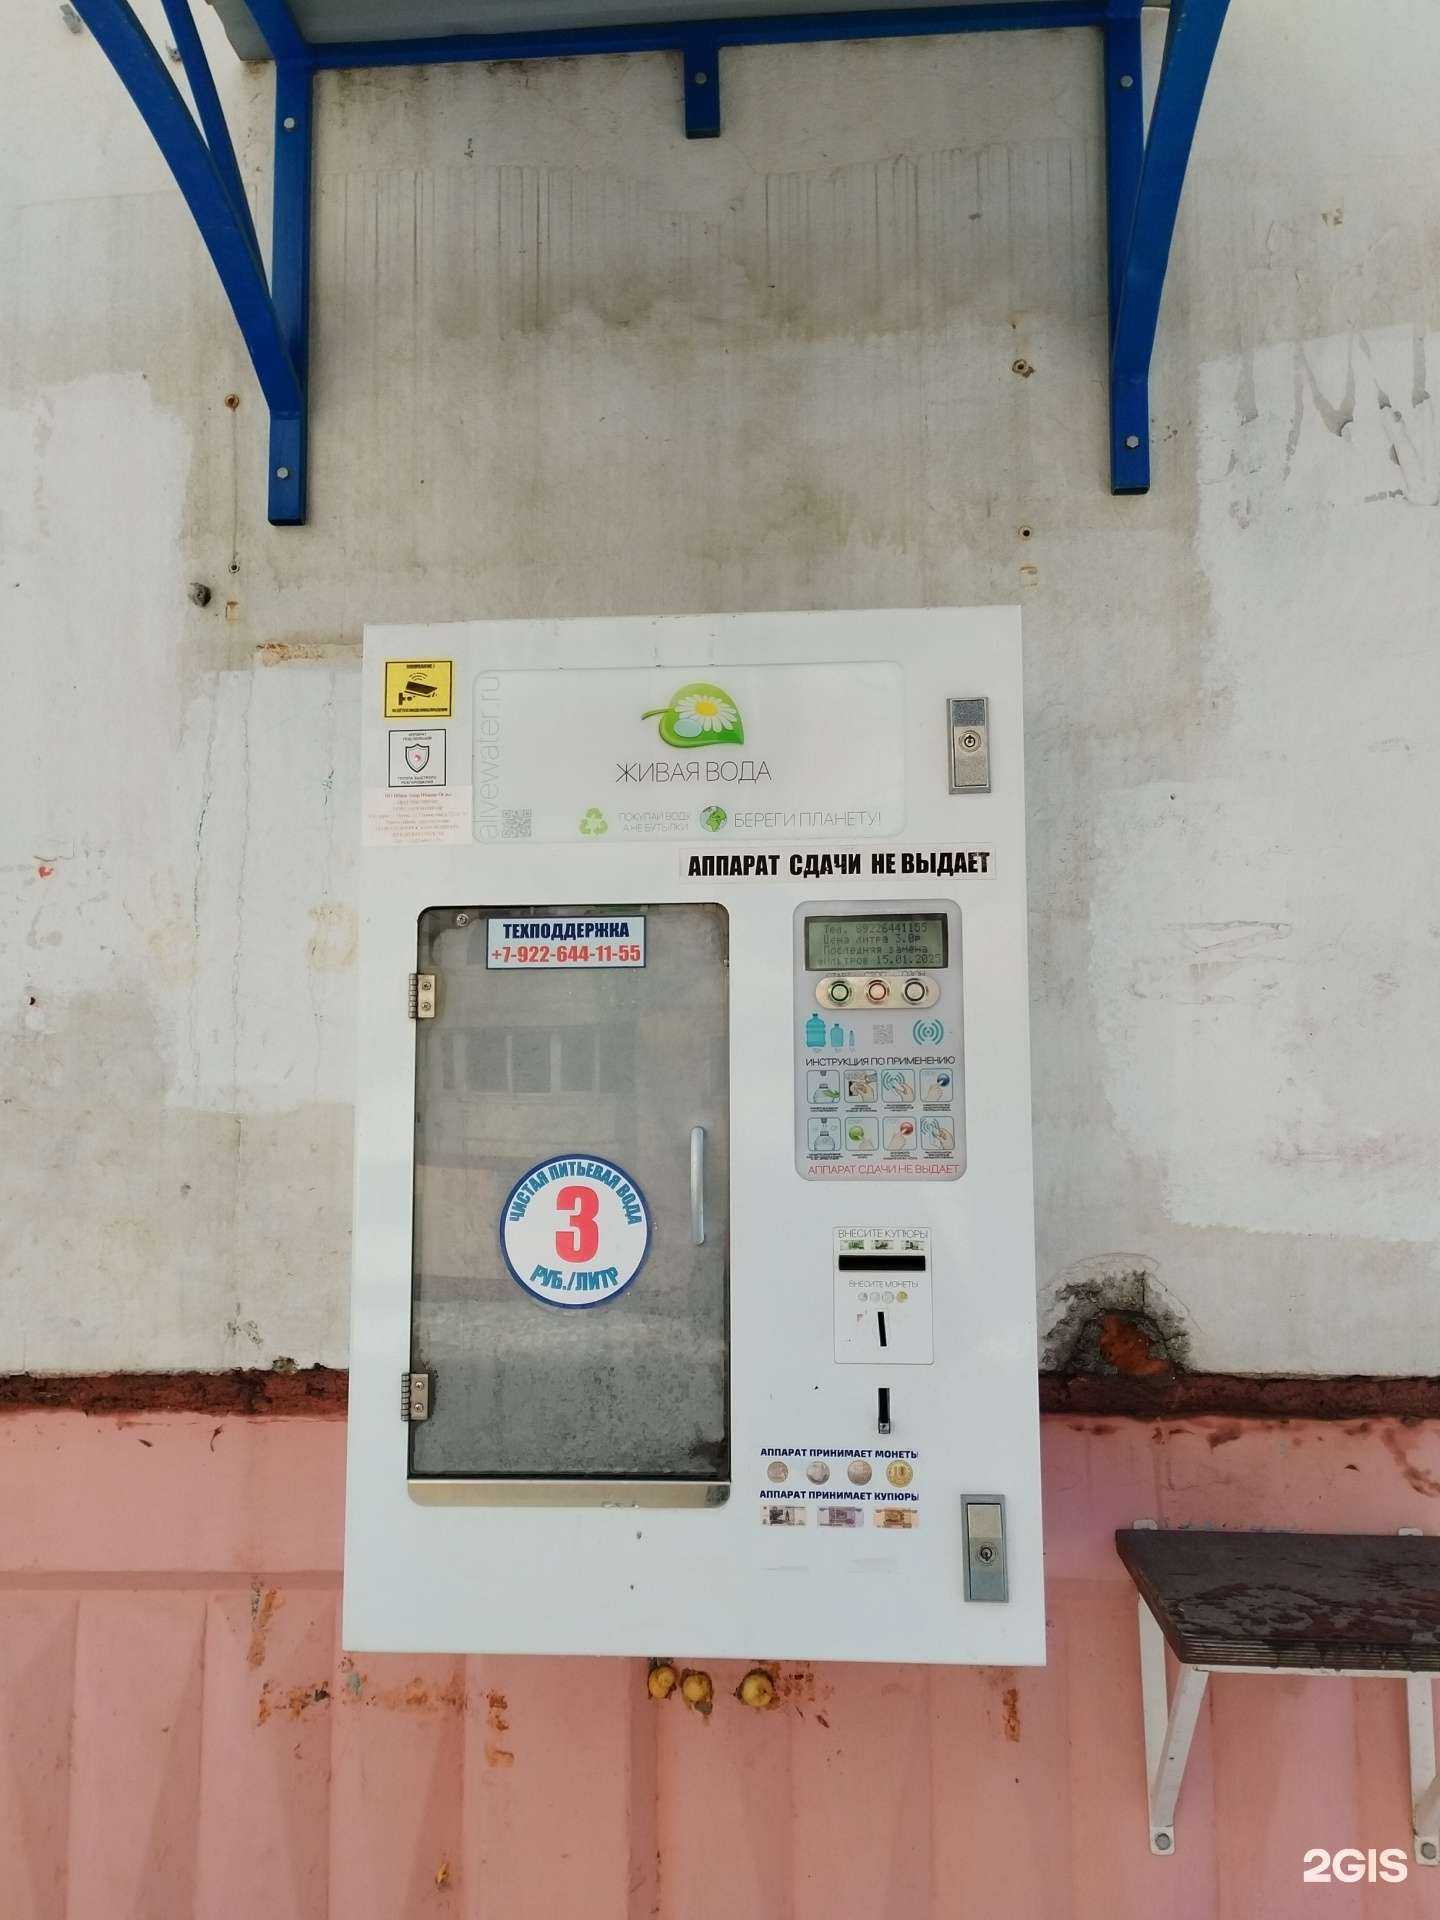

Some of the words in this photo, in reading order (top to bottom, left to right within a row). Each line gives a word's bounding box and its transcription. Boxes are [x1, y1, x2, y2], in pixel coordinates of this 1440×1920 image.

[477, 676, 500, 841] alivewater.ru
[615, 761, 700, 783] ЖИВАЯ
[705, 760, 773, 784] ВОДА
[734, 812, 796, 828] БЕРЕГИ
[799, 811, 881, 827] ПЛАНЕТУ!
[688, 854, 780, 877] АППАРАТ
[789, 853, 862, 878] СДАЧИ
[871, 853, 897, 875] НЕ
[901, 851, 991, 877] ВЫДАЕТ
[502, 922, 630, 941] ТЕХПОДДЕРЖКА
[491, 944, 641, 963] +7-922-644-11-55
[805, 1057, 869, 1067] ИНСТРУКЦИЯ
[870, 1057, 885, 1066] ПО
[886, 1055, 956, 1066] ПРИМЕНЕНИЮ
[808, 1165, 856, 1175] АППАРАТ
[858, 1164, 896, 1175] СДАЧИ
[898, 1164, 913, 1174] НЕ
[914, 1164, 961, 1175] ВЫДАЕТ
[509, 1170, 551, 1222] ЧИСТАЯ
[548, 1161, 622, 1188] ПИТЬЕВАЯ
[615, 1183, 643, 1225] ВОДА
[555, 1185, 600, 1264] 3
[838, 1229, 883, 1239] ВНЕСИТЕ
[884, 1229, 929, 1239] КУПЮРЫ
[530, 1264, 619, 1291] РУБ./ЛИТР
[848, 1280, 883, 1288] ВНЕСИТЕ
[884, 1280, 919, 1289] МОНЕТЫ
[760, 1448, 808, 1457] АППАРАТ
[809, 1448, 873, 1459] ПРИНИМАЕТ
[874, 1449, 919, 1460] МОНЕТЫ
[759, 1490, 807, 1500] АППАРАТ
[808, 1490, 873, 1501] ПРИНИМАЕТ
[874, 1491, 919, 1501] КУПЮРЫ
